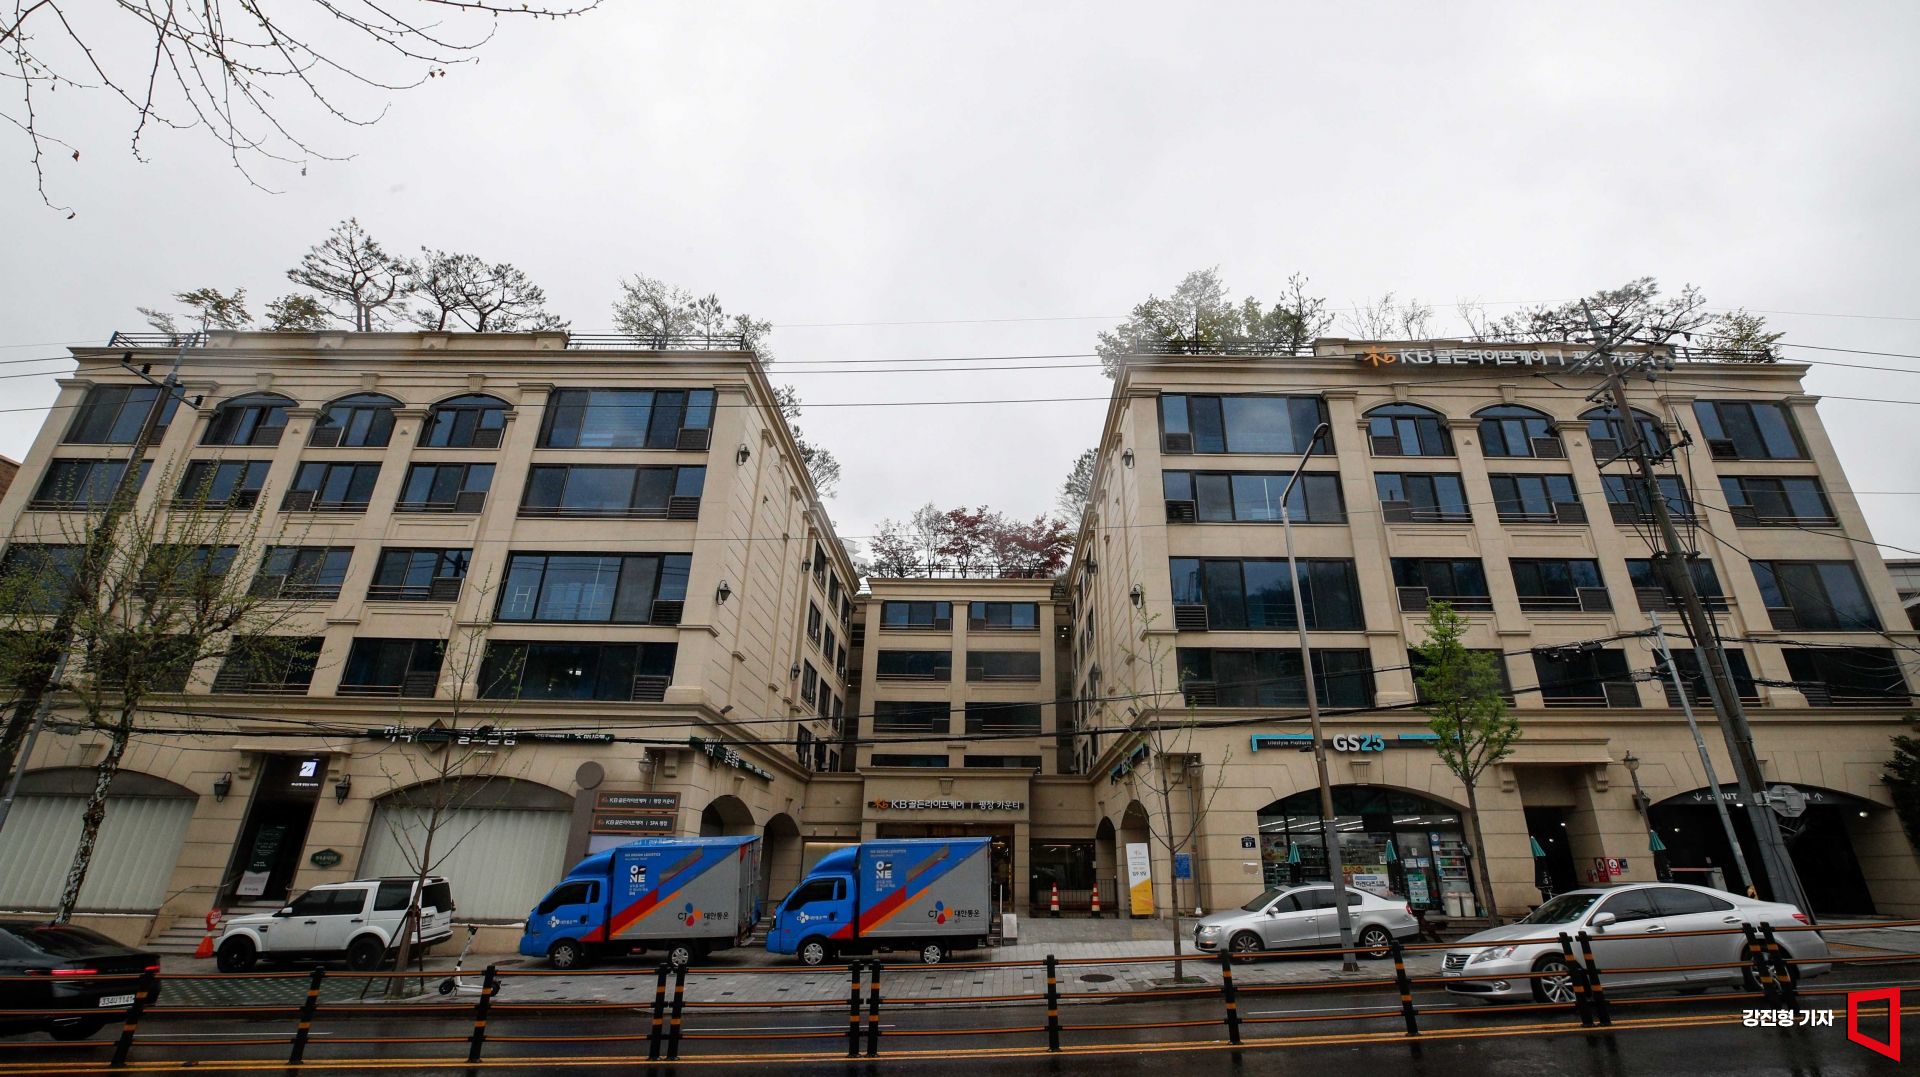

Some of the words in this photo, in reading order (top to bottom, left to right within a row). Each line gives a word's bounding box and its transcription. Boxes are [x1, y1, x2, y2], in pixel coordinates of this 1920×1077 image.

[1332, 734, 1385, 752] GS25
[978, 799, 994, 810] 평창
[996, 799, 1020, 810] 카운티
[677, 912, 687, 921] CJ
[928, 910, 938, 919] CJ
